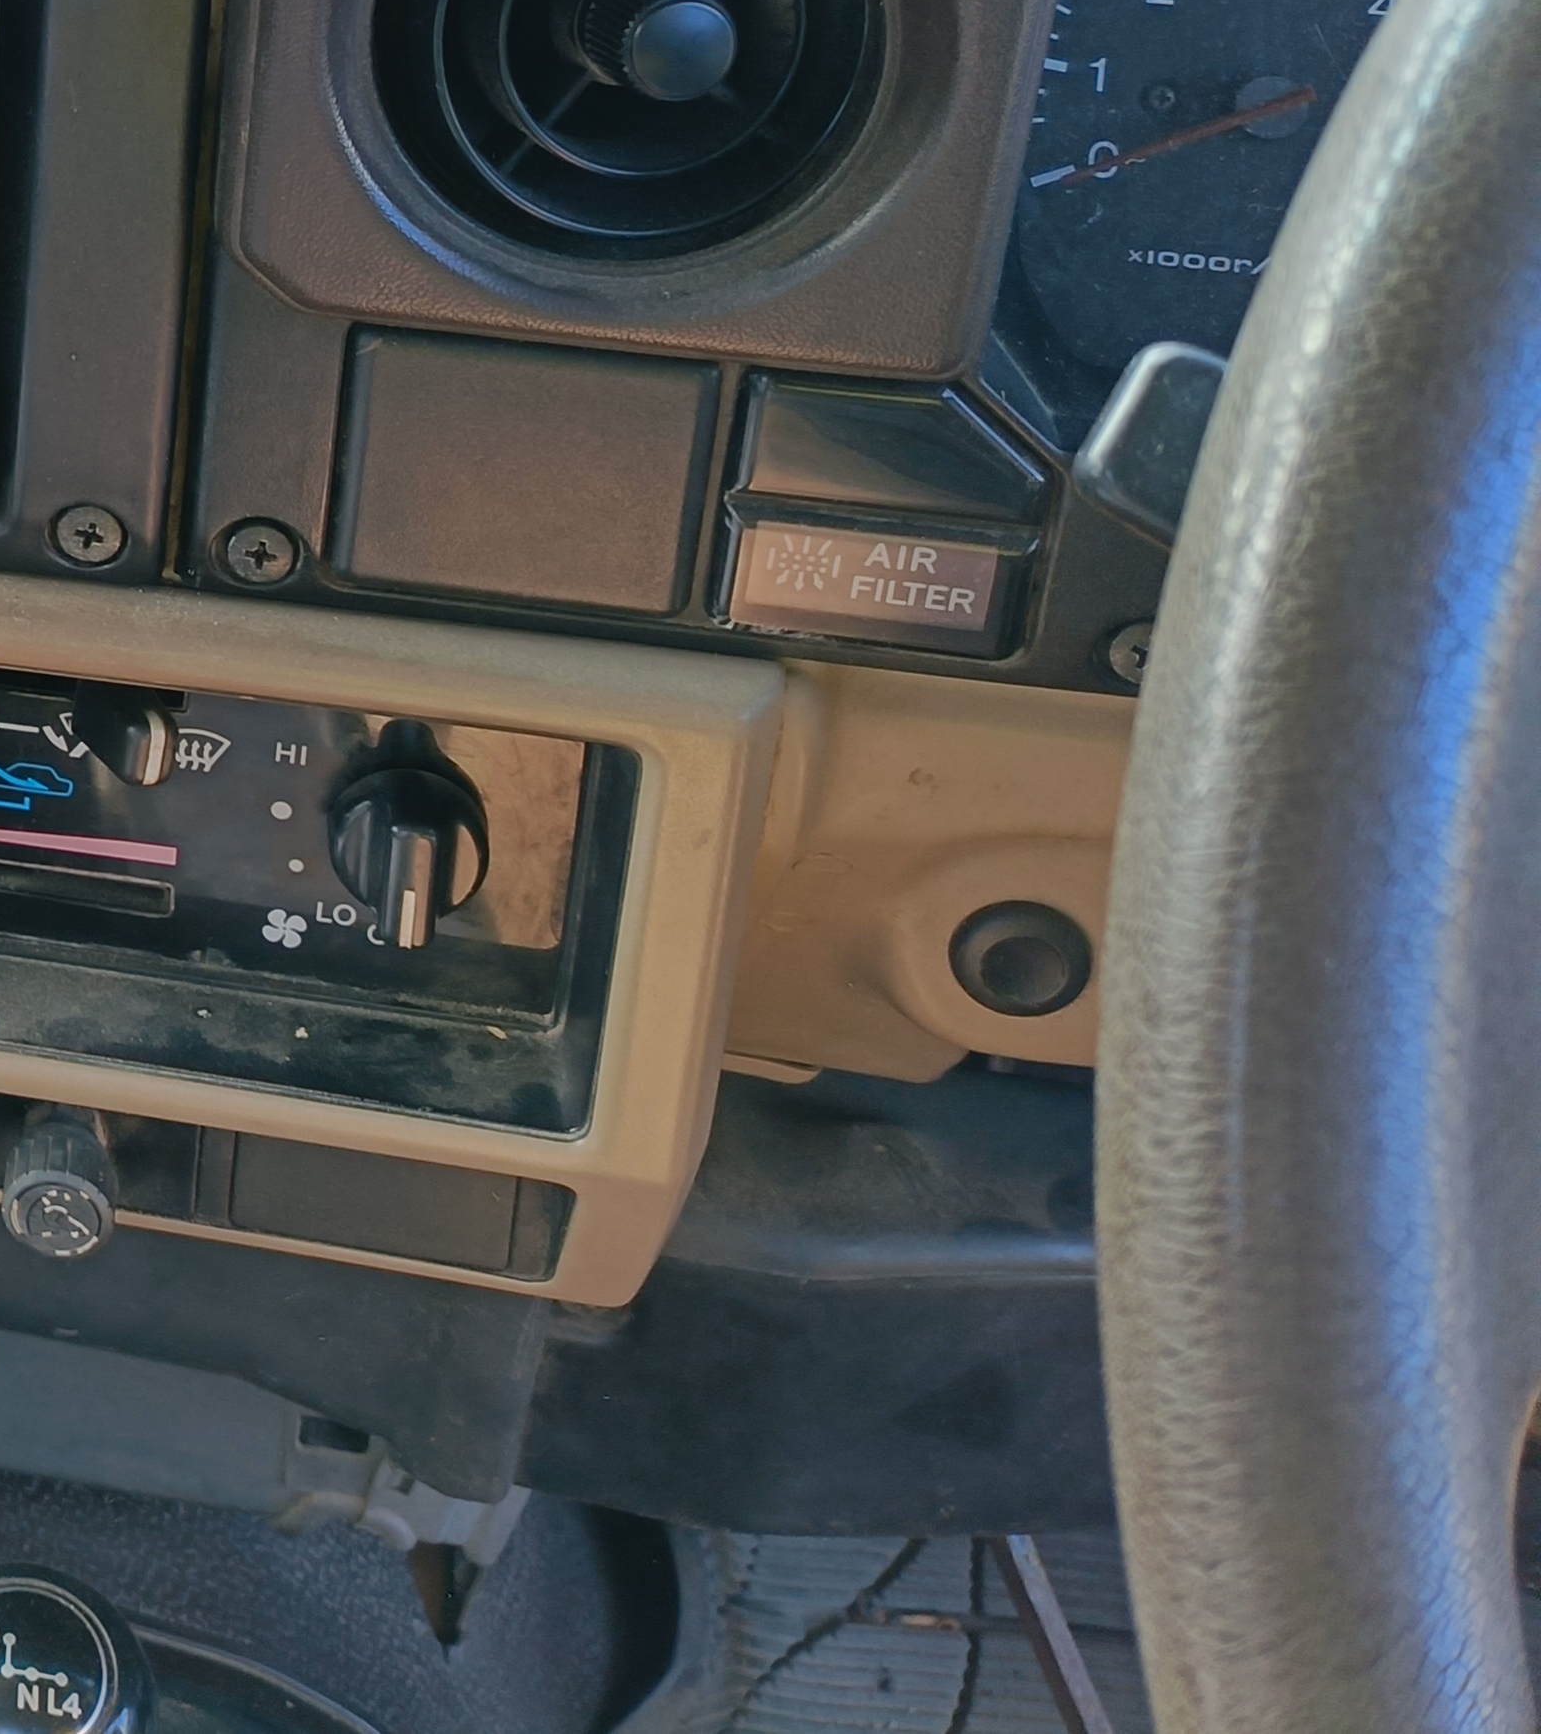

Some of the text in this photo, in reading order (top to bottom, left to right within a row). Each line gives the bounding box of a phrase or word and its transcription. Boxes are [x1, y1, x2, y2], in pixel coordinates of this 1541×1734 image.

[1089, 57, 1107, 92] 1
[1088, 140, 1119, 179] 0
[864, 542, 938, 575] AIR
[849, 575, 976, 615] FILTER
[275, 741, 308, 766] HI
[315, 901, 357, 927] LO
[18, 1682, 82, 1720] N L4
